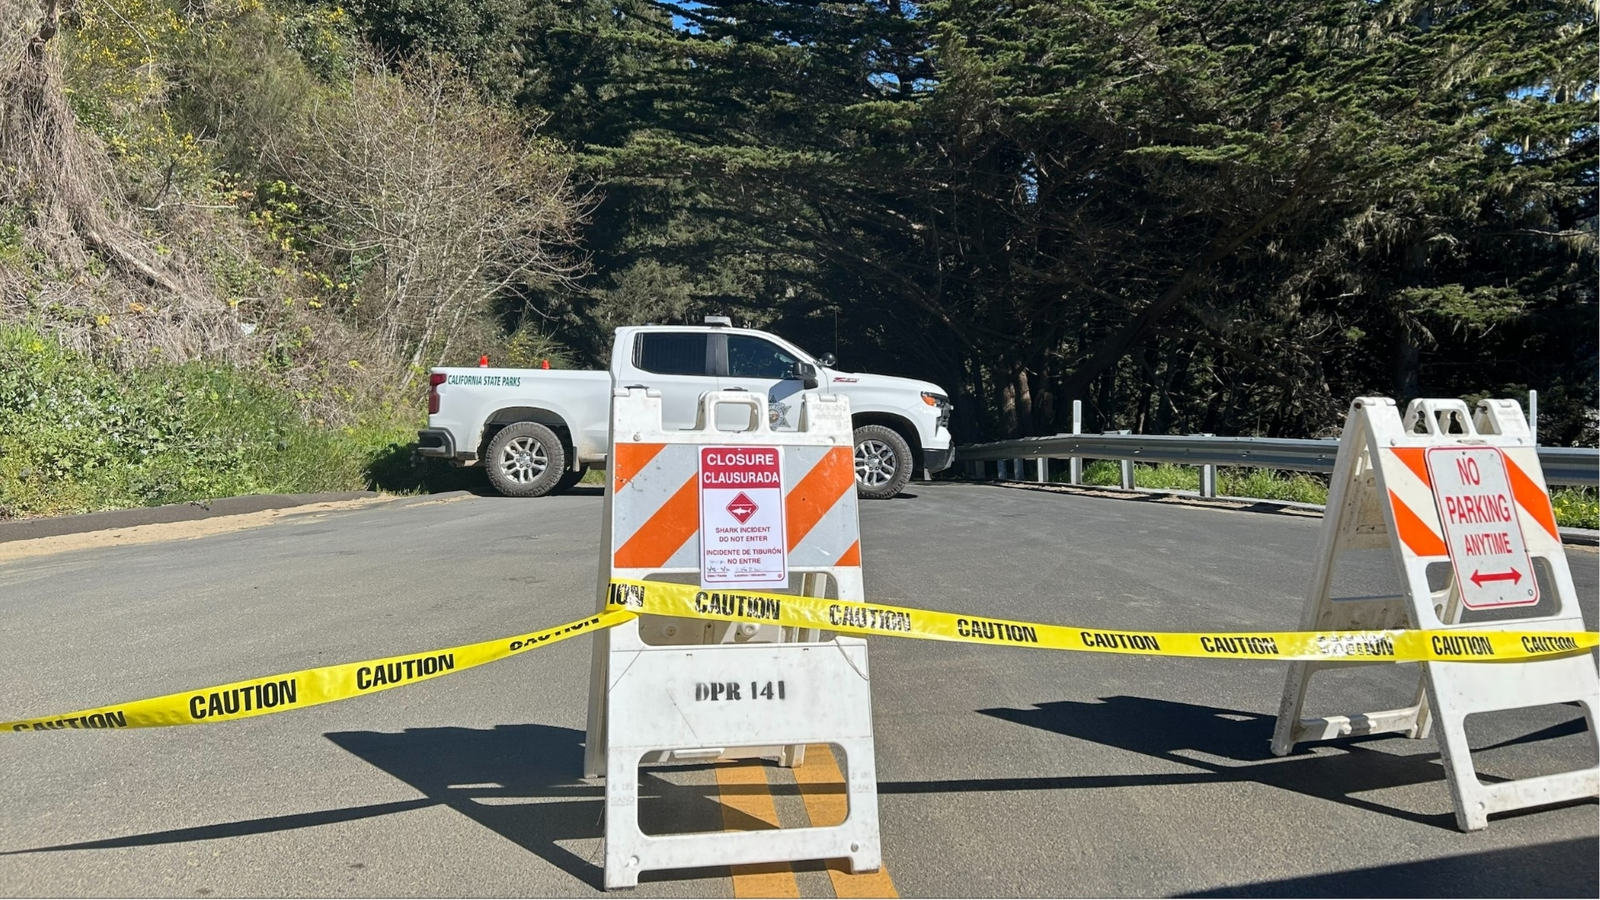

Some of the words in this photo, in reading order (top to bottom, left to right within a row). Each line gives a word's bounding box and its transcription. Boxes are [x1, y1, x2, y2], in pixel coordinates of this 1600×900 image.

[447, 374, 482, 385] CALIFORNIA
[483, 376, 500, 386] STATE
[501, 376, 521, 387] PARKS
[706, 453, 775, 466] CLOSURE
[703, 471, 780, 483] CLAUSURADA
[1456, 457, 1480, 486] NO
[1445, 494, 1512, 525] PARKING
[753, 547, 782, 555] TIBURÓN
[1464, 532, 1513, 556] ANYTIME
[695, 591, 780, 620] CAUTION
[829, 604, 911, 632] CAUTION
[957, 618, 1038, 643] CAUTION
[1080, 631, 1161, 651] CAUTION
[1200, 636, 1279, 655] CAUTION
[1431, 635, 1495, 656] CAUTION
[356, 654, 454, 690] CAUTION
[189, 679, 297, 720] CAUTION
[695, 682, 742, 702] DPR
[751, 680, 786, 700] 141
